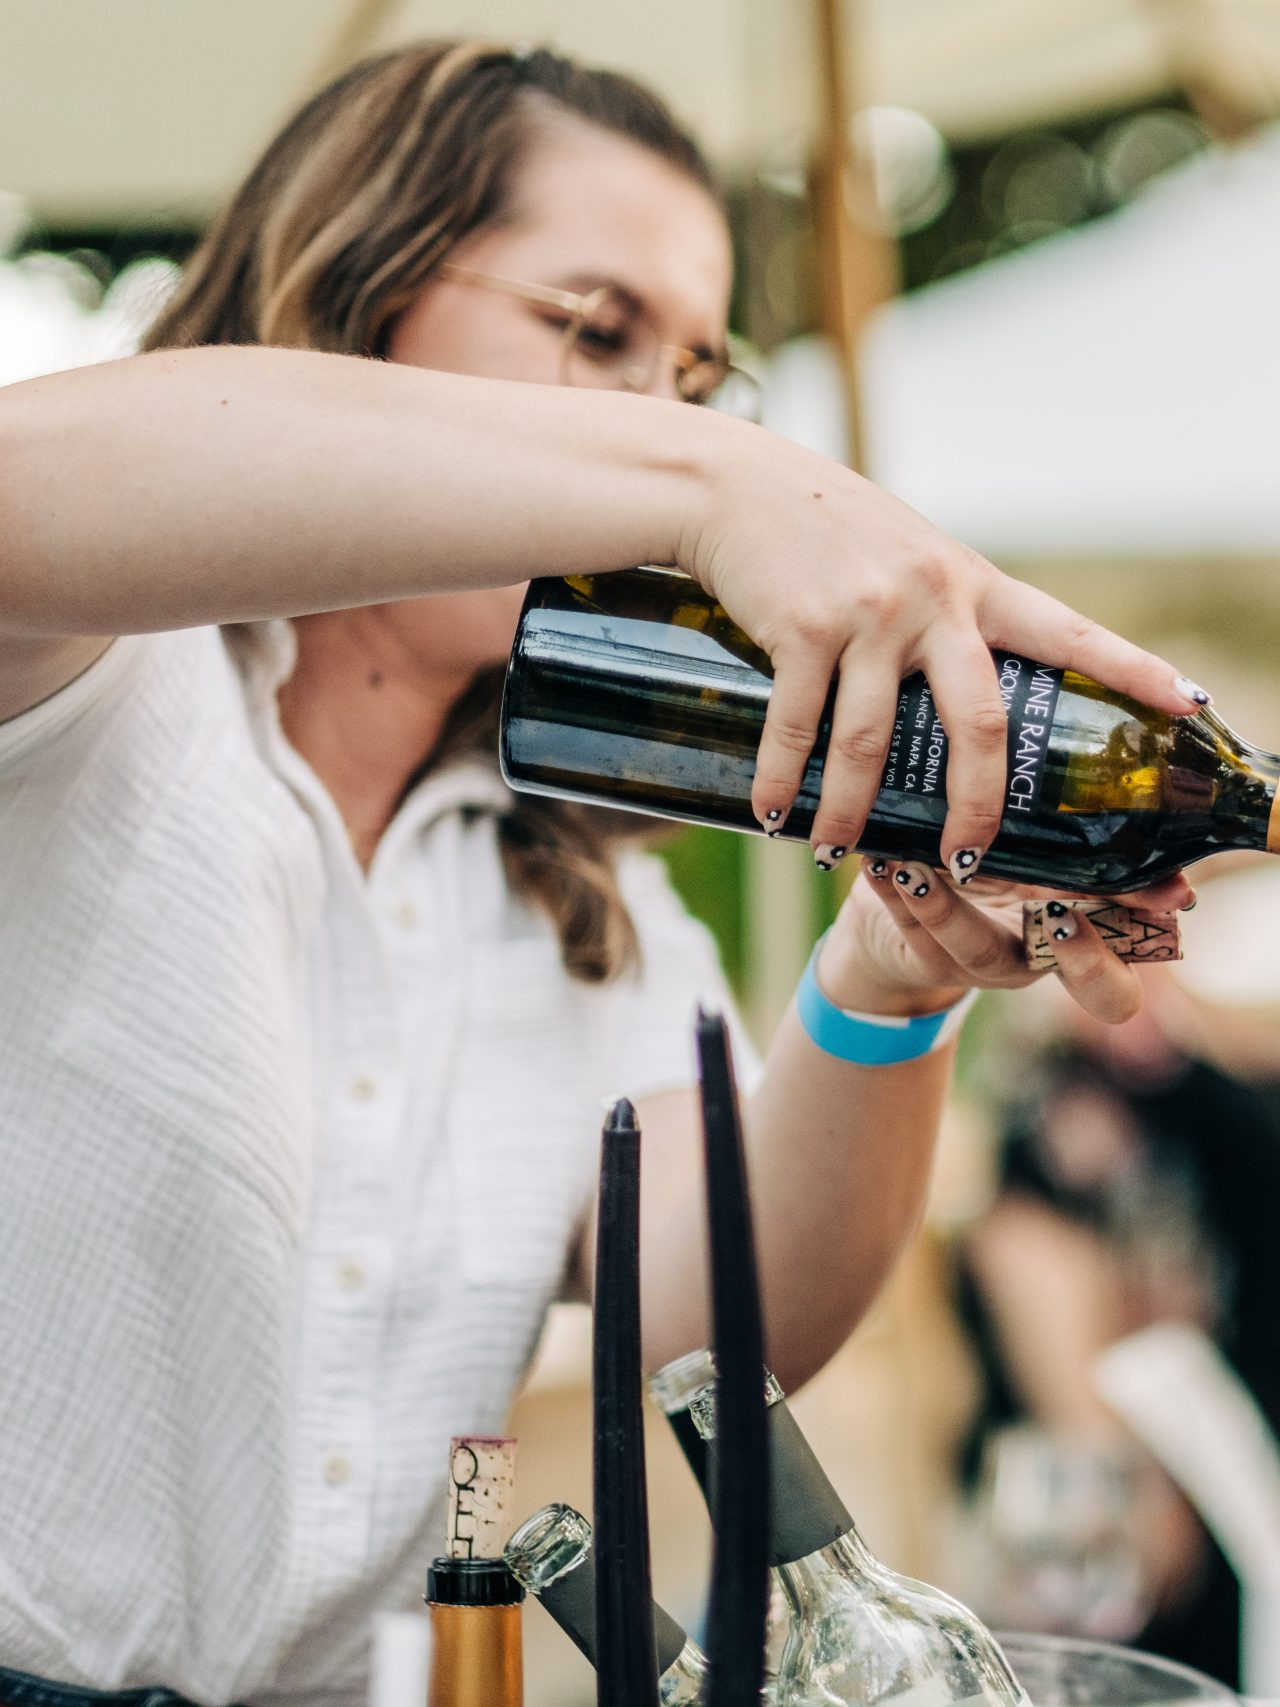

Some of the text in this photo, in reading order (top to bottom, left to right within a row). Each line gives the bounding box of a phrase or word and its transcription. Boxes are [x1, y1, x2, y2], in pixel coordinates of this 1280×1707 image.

[915, 688, 931, 729] RANCH
[889, 752, 898, 764] BY
[922, 713, 945, 792] ALIFORNIA
[1008, 722, 1044, 812] RANCH
[886, 768, 896, 787] VOL
